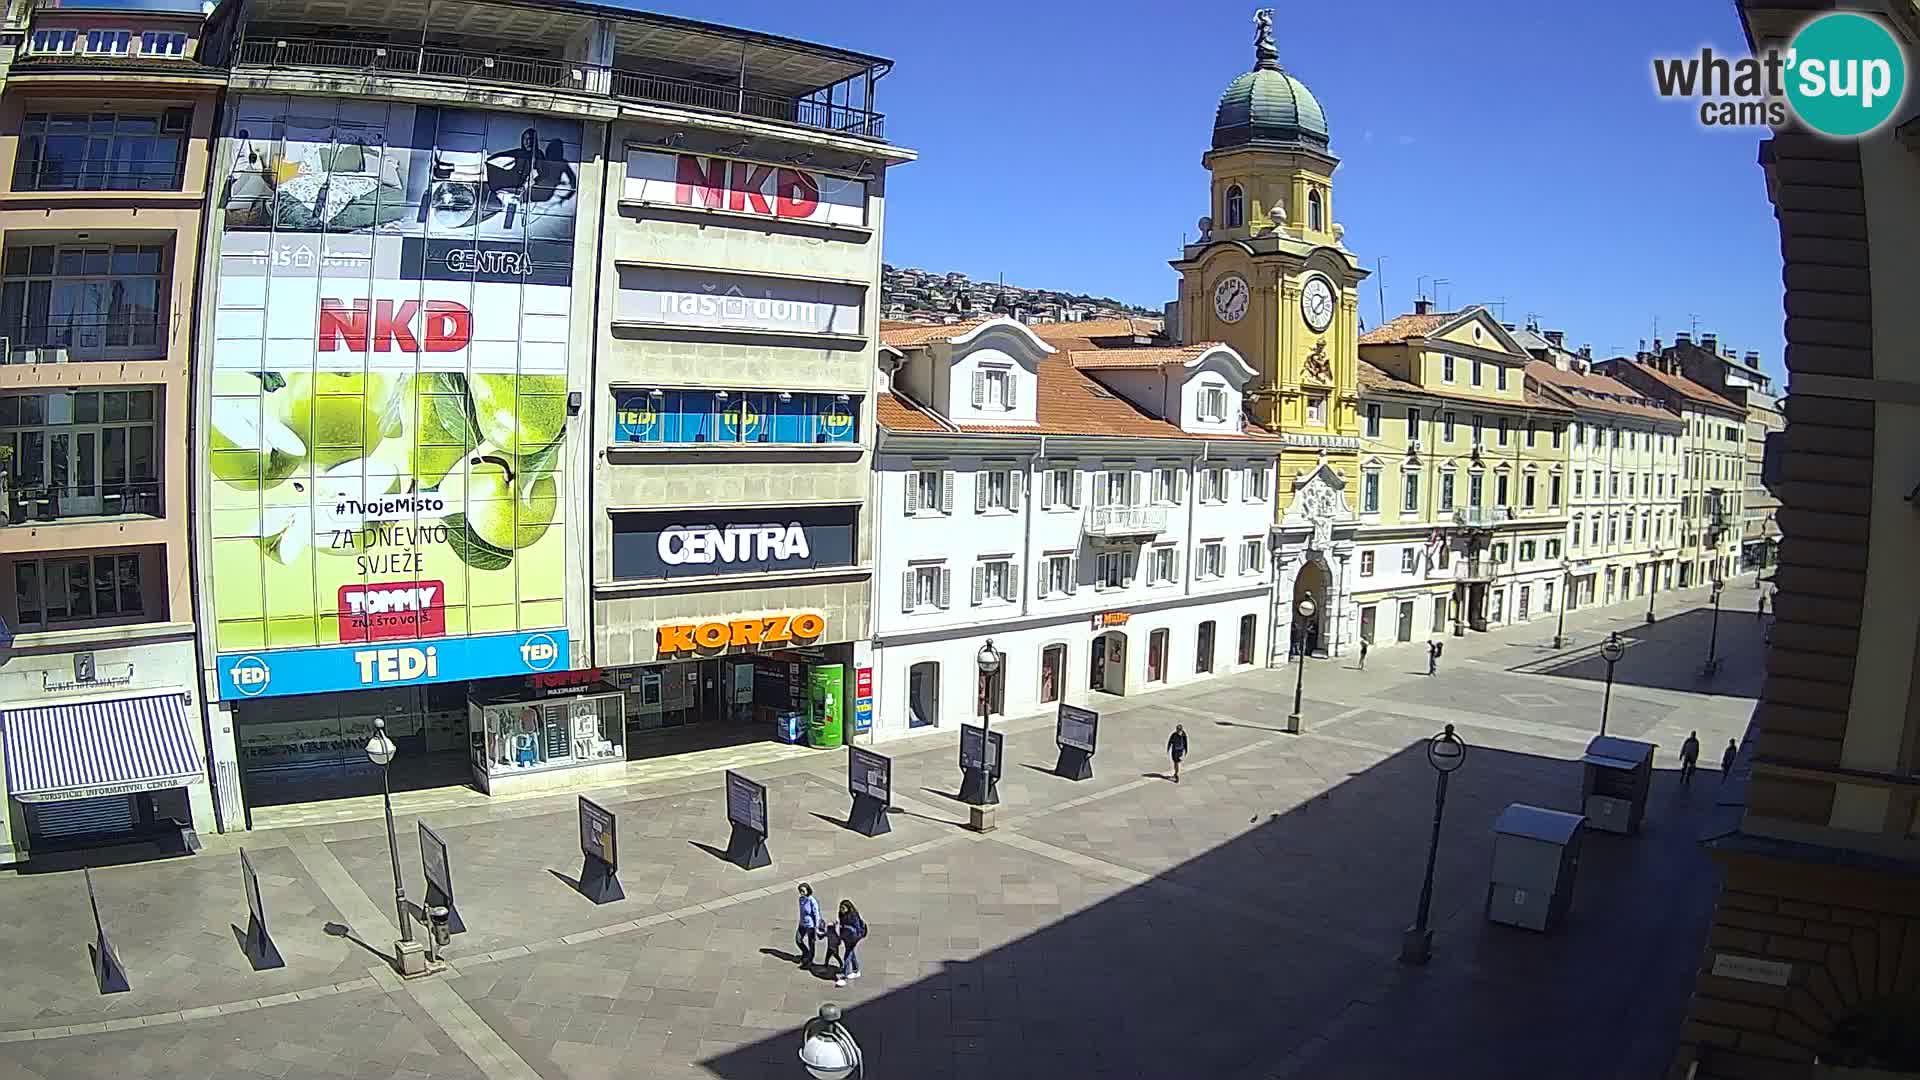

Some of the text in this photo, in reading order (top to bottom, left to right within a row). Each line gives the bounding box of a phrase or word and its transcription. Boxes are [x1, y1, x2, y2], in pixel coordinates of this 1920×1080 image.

[674, 155, 820, 219] NKD
[445, 248, 533, 275] CENTRA
[318, 297, 474, 353] NKD
[335, 497, 444, 517] #TvojeMisto
[331, 524, 449, 549] ZA DNEVNO
[657, 521, 810, 565] CENTRA
[357, 548, 424, 575] SVJEŽE
[346, 586, 437, 614] TOMMY
[377, 615, 397, 627] ŠTO
[657, 613, 824, 653] KORZO
[520, 641, 558, 661] TEDi
[229, 664, 271, 685] TEDi
[354, 646, 438, 684] TEDi
[146, 779, 179, 790] CENTAR
